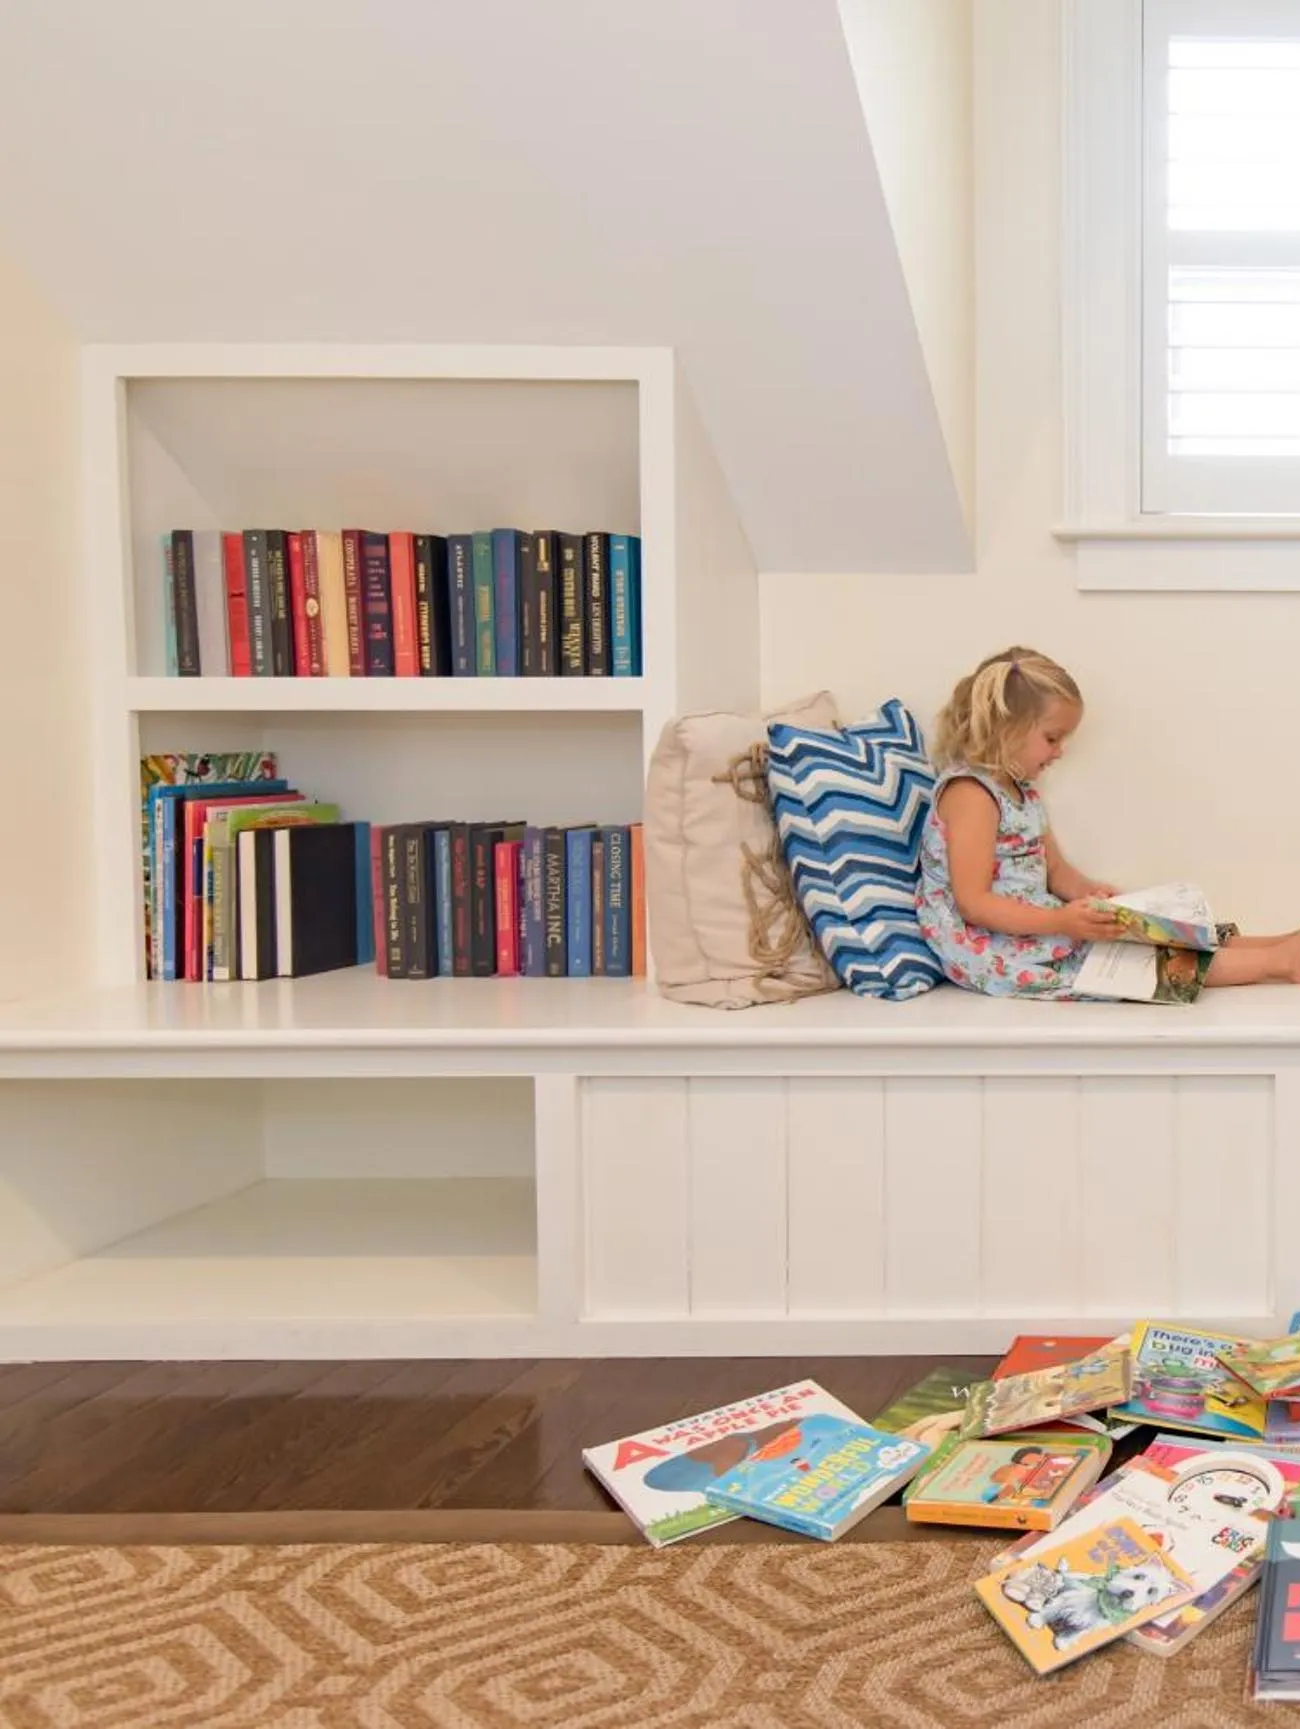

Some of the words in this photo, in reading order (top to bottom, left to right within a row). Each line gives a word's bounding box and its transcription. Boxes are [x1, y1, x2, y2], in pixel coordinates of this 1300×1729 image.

[609, 833, 621, 879] CLOSING
[546, 853, 561, 911] MARTHA
[609, 883, 621, 909] TIME
[546, 915, 562, 949] INC.
[1151, 1340, 1193, 1356] bug
[1152, 1330, 1215, 1349] There's
[1193, 1356, 1221, 1370] m
[612, 1440, 671, 1471] A
[651, 1424, 706, 1446] WAS
[711, 1401, 774, 1426] ONCE
[783, 1387, 817, 1405] AN
[686, 1414, 759, 1447] APPLE
[766, 1402, 802, 1418] PIE
